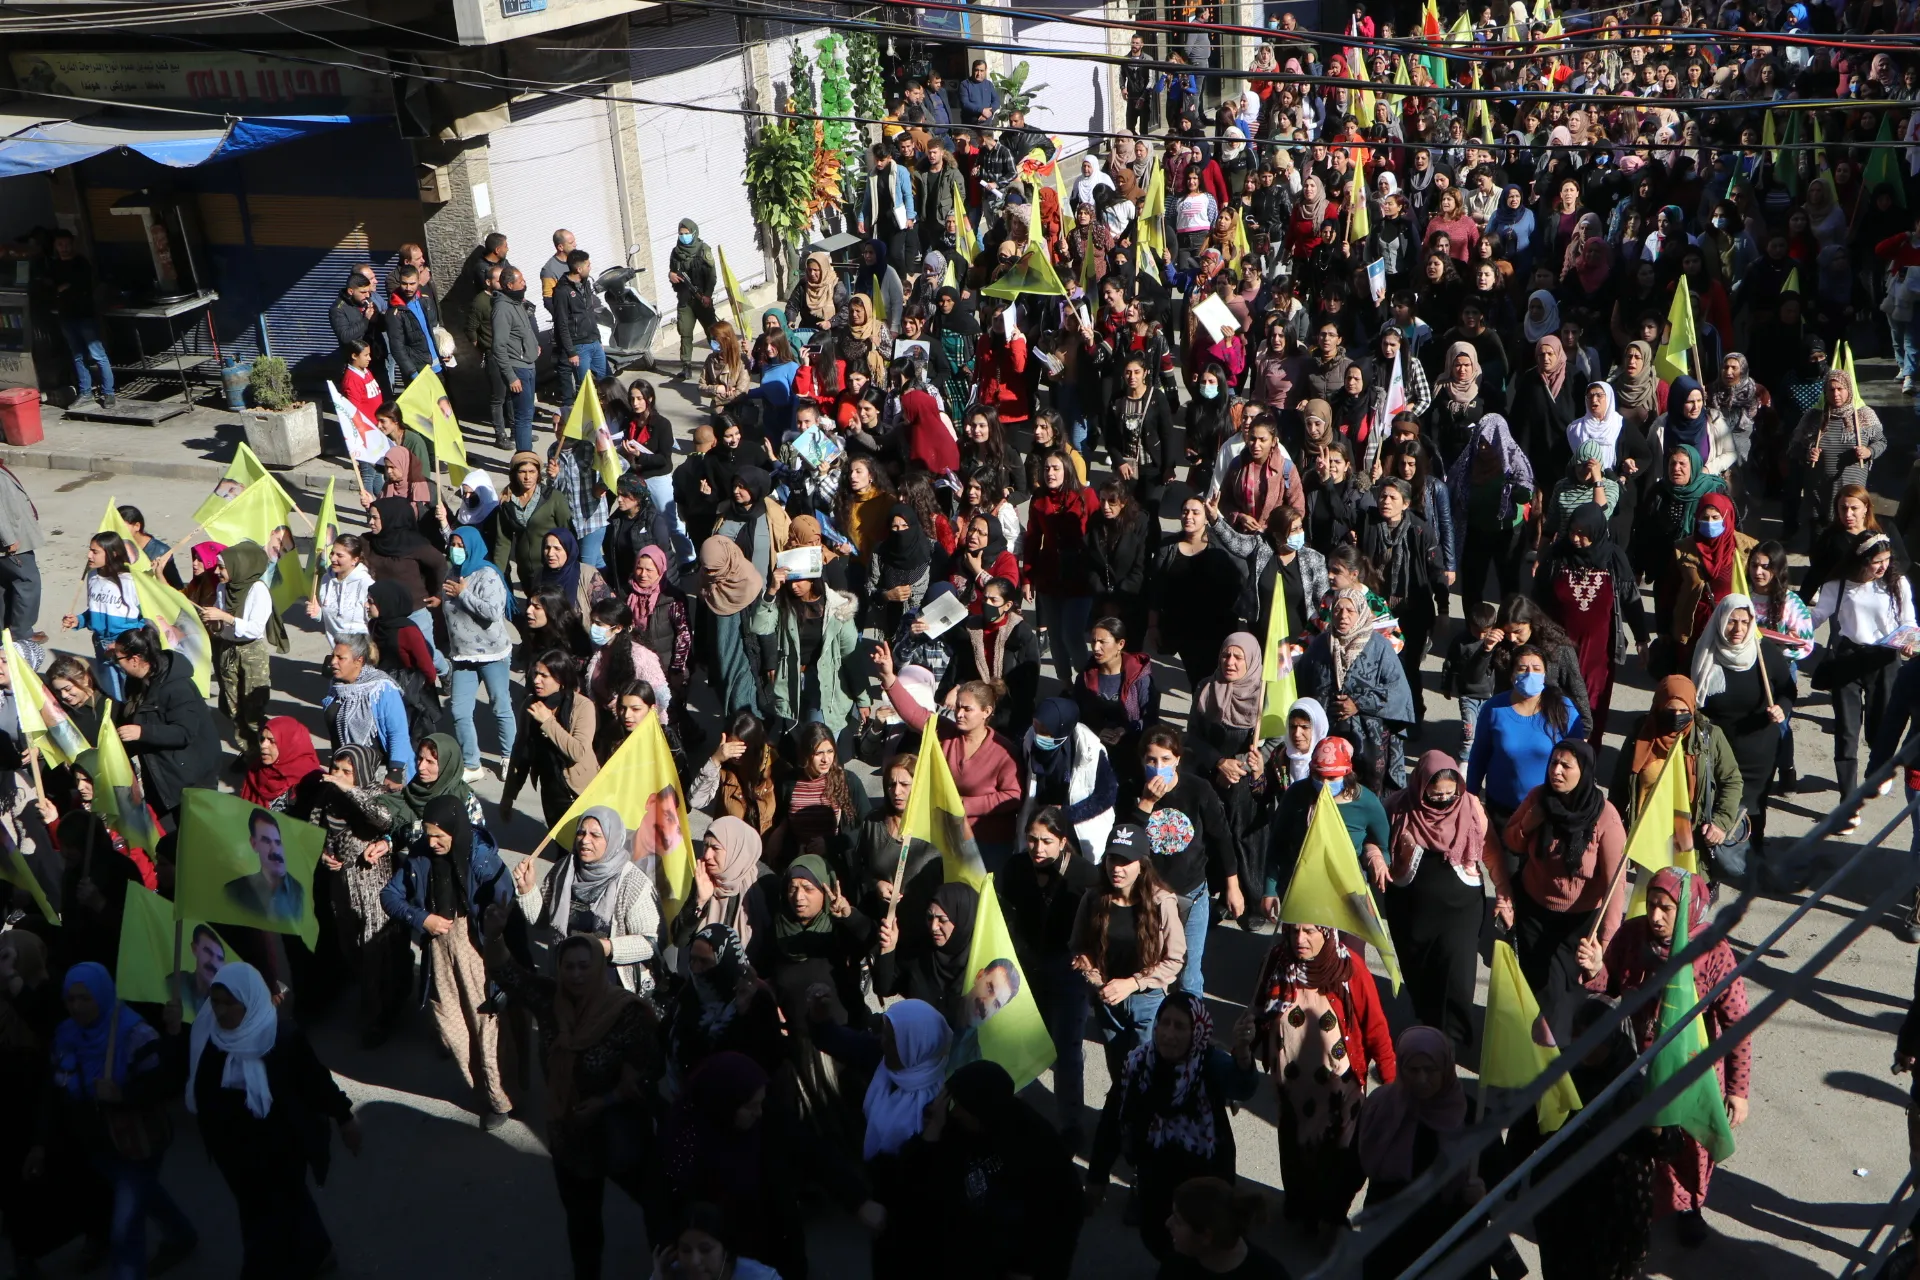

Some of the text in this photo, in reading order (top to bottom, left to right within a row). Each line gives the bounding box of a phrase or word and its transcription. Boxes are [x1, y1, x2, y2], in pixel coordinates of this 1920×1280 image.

[136, 60, 154, 74] تبديل
[155, 60, 169, 74] قطع
[170, 62, 180, 74] بيع
[1112, 837, 1133, 846] adidas
